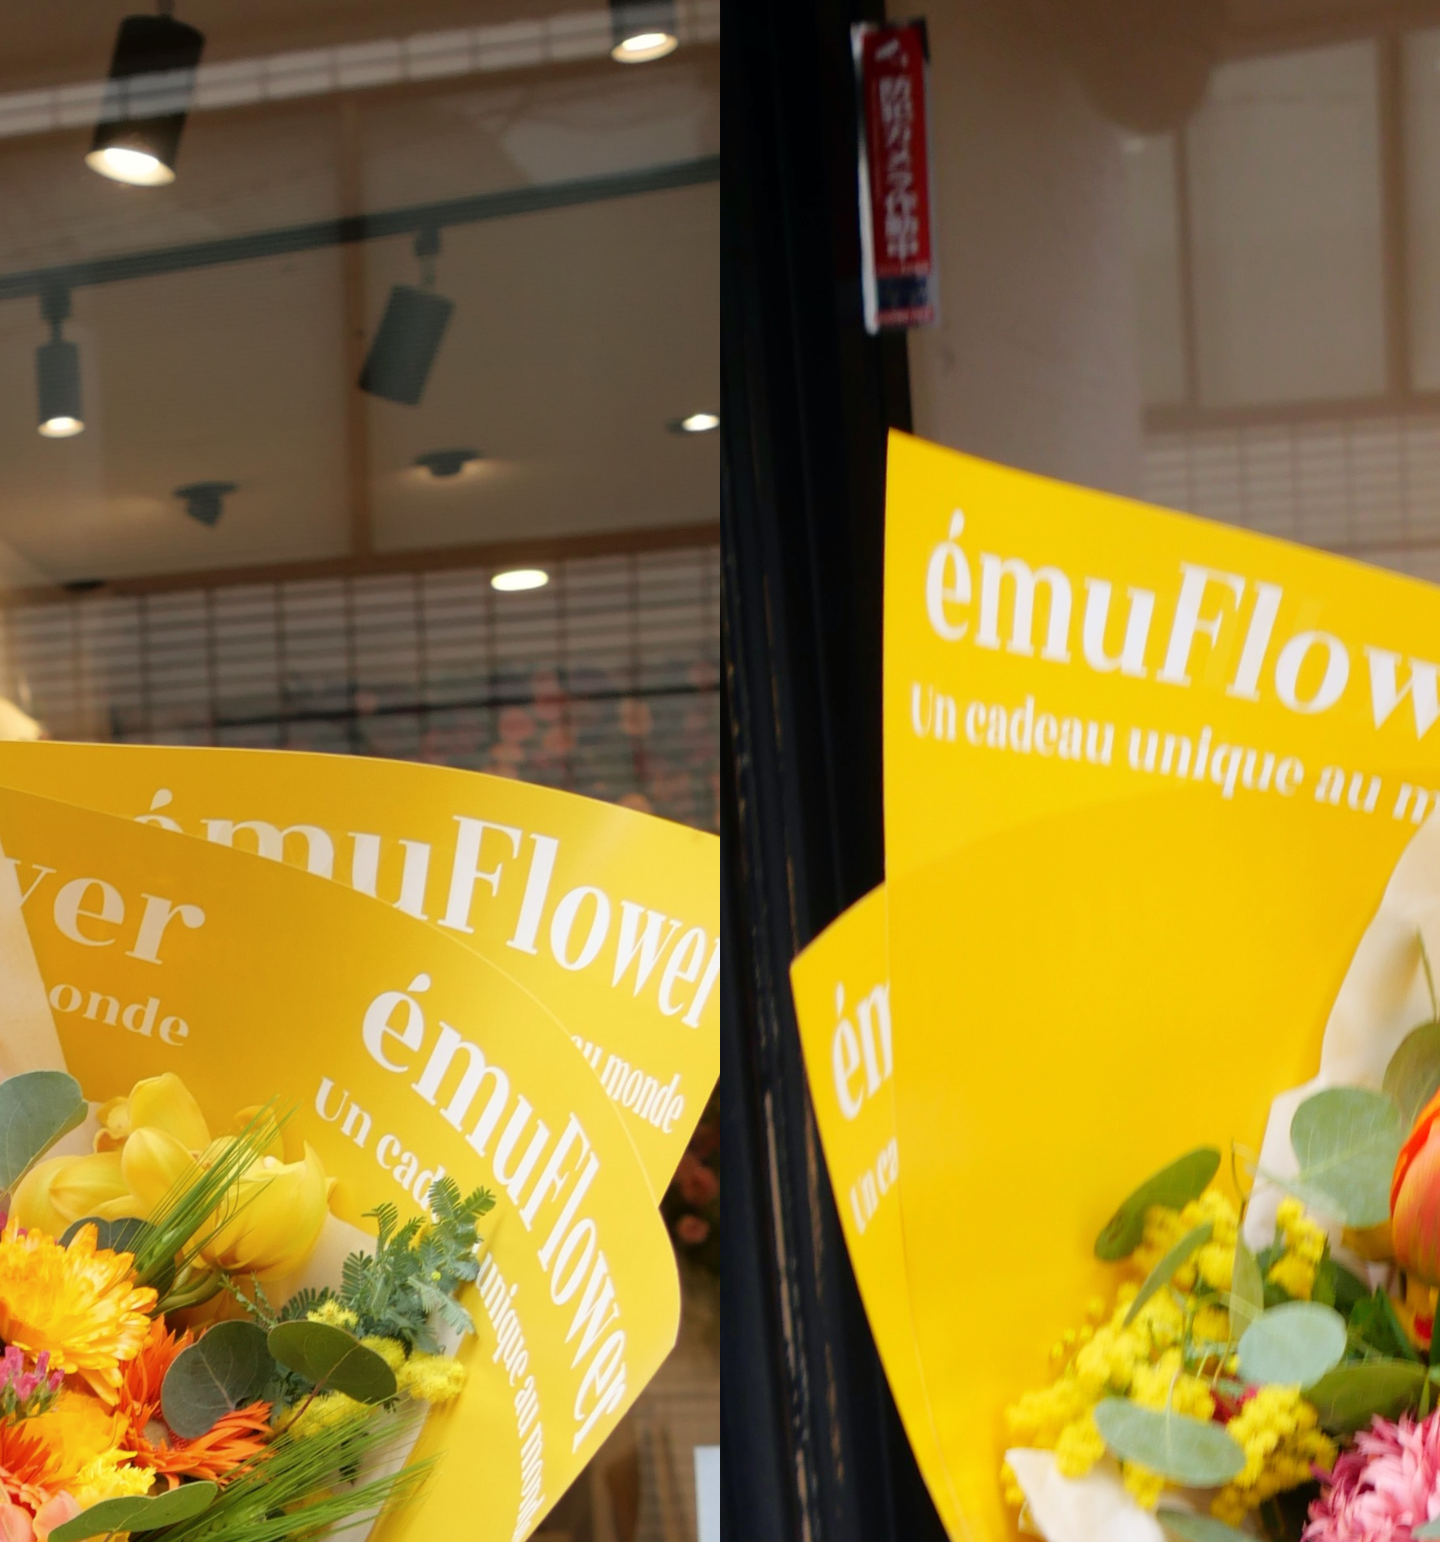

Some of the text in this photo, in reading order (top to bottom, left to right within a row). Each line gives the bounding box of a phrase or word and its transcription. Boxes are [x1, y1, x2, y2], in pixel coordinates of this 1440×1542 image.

[911, 682, 956, 743] Un
[965, 694, 1114, 766] cadeau
[1126, 725, 1304, 800] unique
[1314, 764, 1382, 815] au
[49, 984, 191, 1046] onde
[314, 1076, 367, 1148] Un
[375, 1127, 442, 1222] cad
[476, 1250, 529, 1387] unique
[362, 972, 626, 1454] émuFlower
